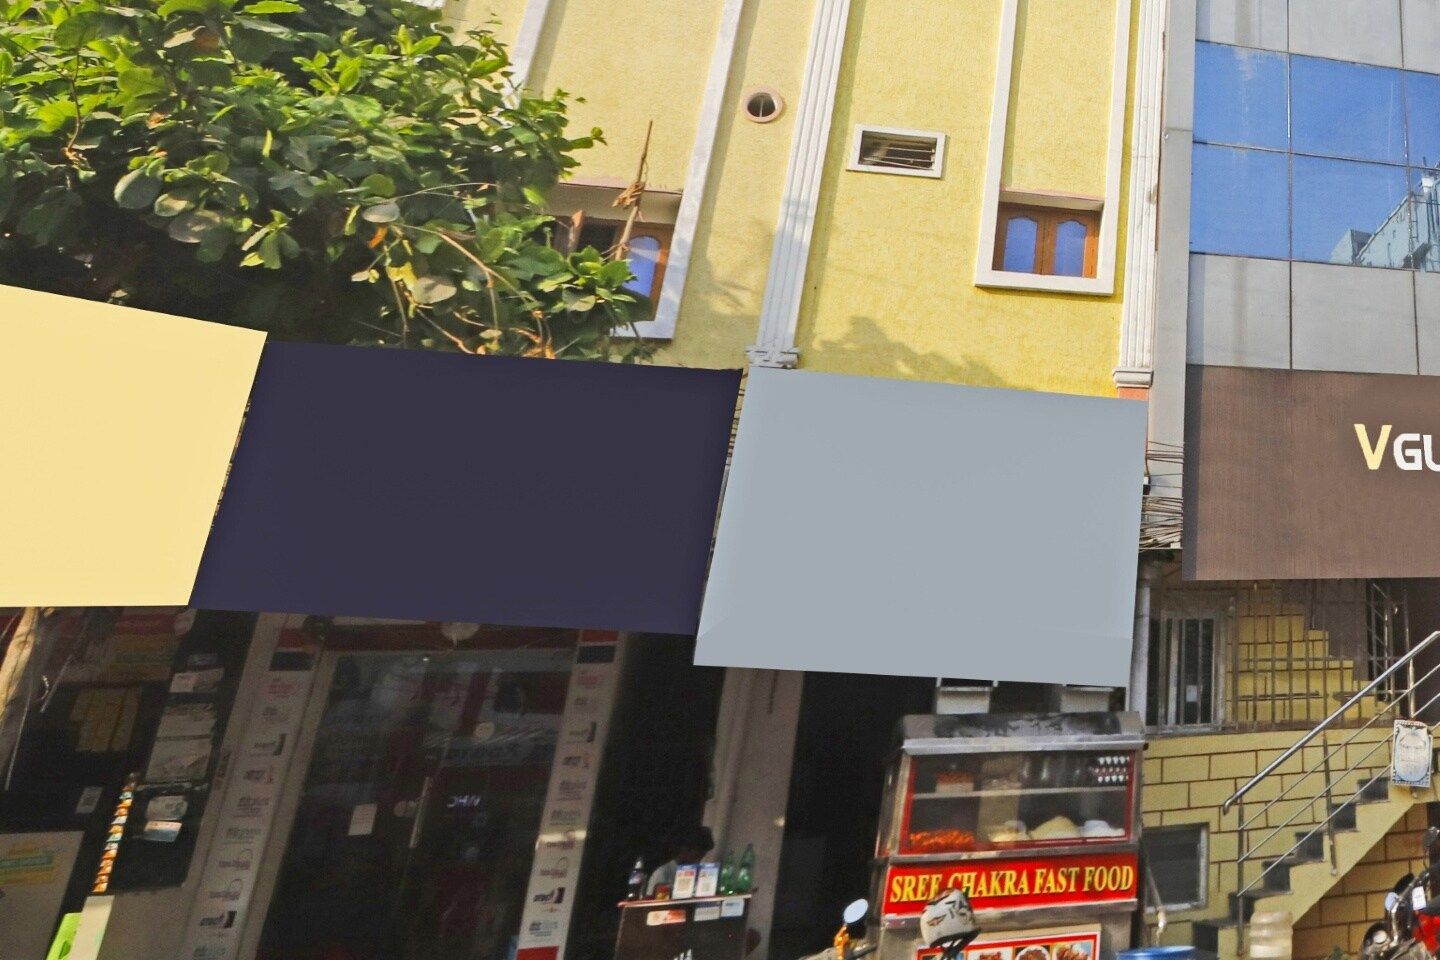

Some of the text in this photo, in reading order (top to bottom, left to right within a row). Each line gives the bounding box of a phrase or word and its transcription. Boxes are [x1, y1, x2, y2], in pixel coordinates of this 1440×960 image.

[948, 869, 1029, 899] CHAKRA
[1033, 866, 1080, 896] FAST
[1081, 864, 1134, 892] FOOD
